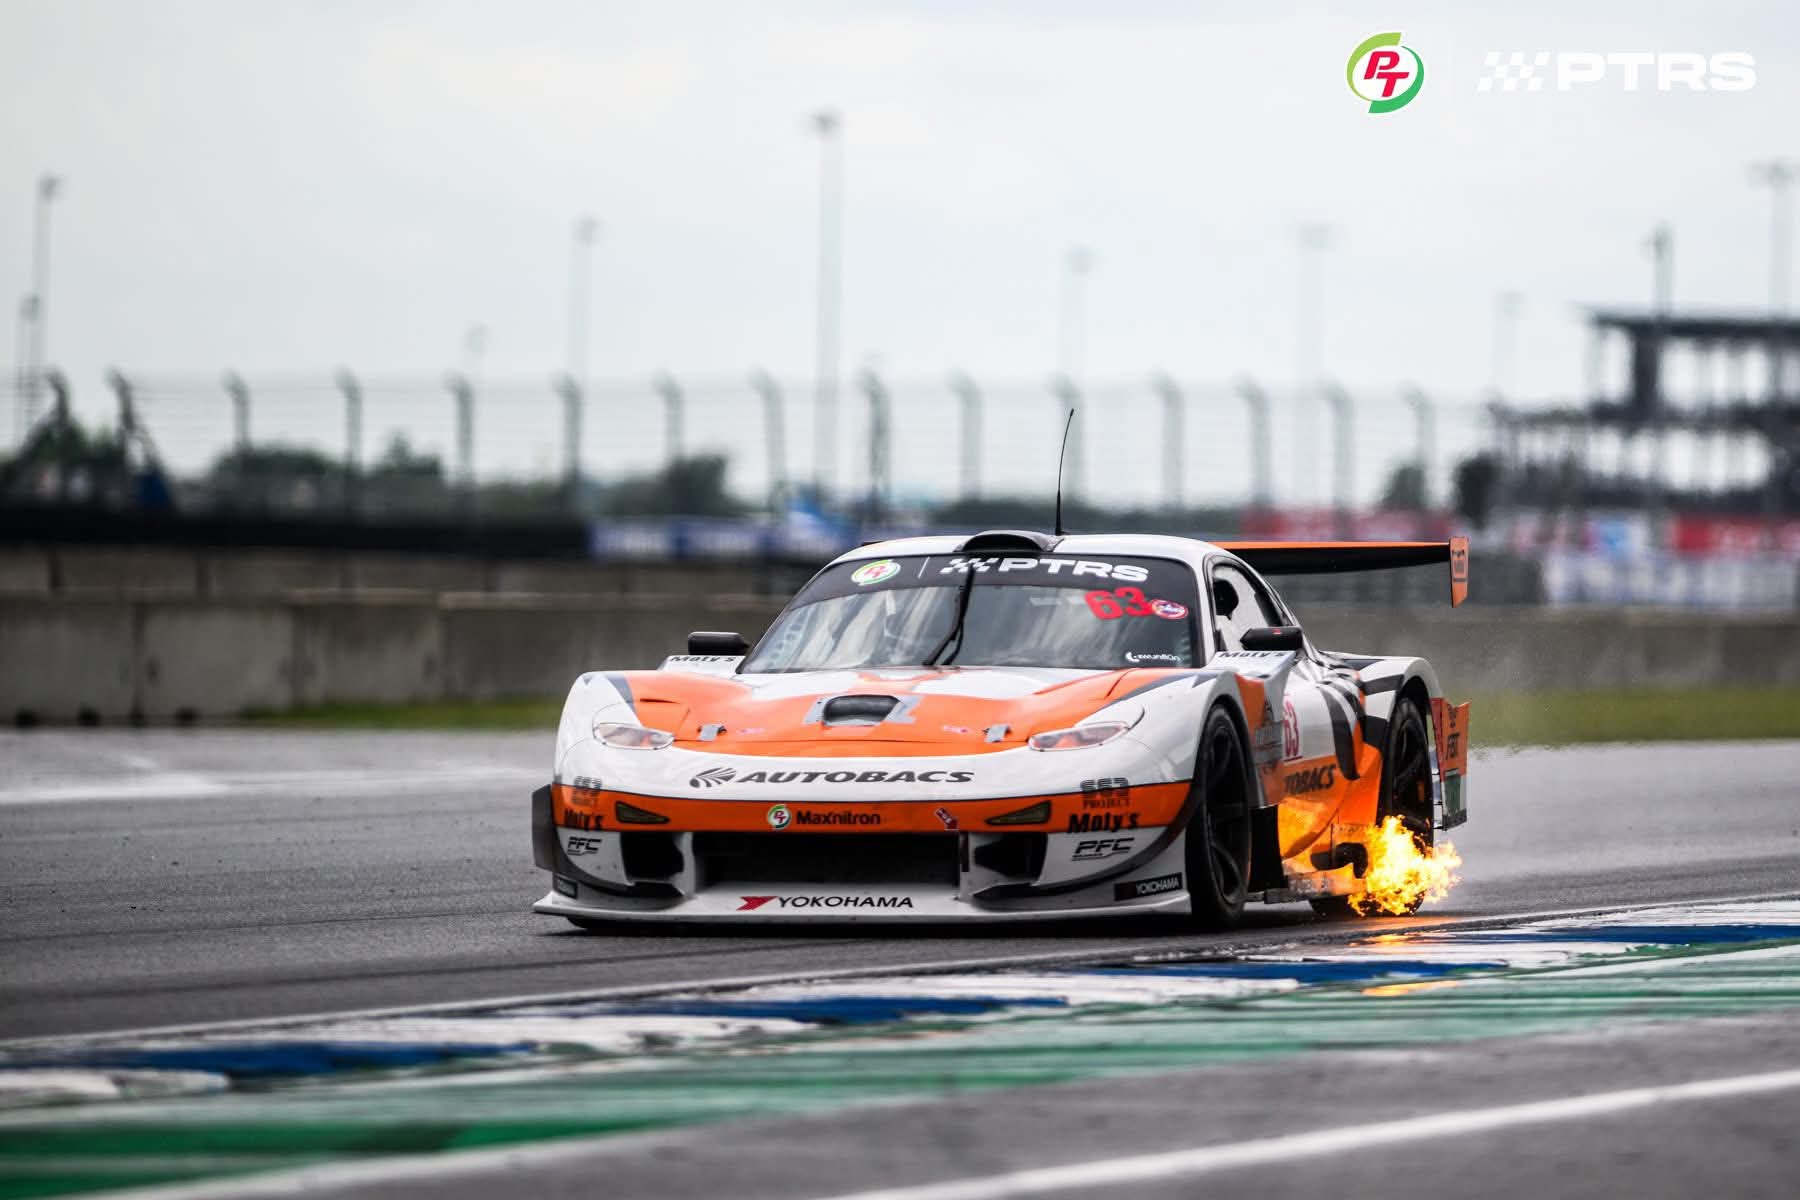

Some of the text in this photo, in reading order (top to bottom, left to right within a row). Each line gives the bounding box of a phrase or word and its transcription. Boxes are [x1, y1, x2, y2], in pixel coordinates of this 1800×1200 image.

[998, 557, 1149, 582] PTRS
[1084, 586, 1155, 620] 63
[735, 771, 975, 783] AUTOBACS
[796, 810, 881, 825] Maxnitron
[568, 836, 603, 851] PFC
[1074, 837, 1135, 854] PFC
[1136, 876, 1180, 895] YOKOHAMA
[778, 896, 914, 908] YOKOHAMA
